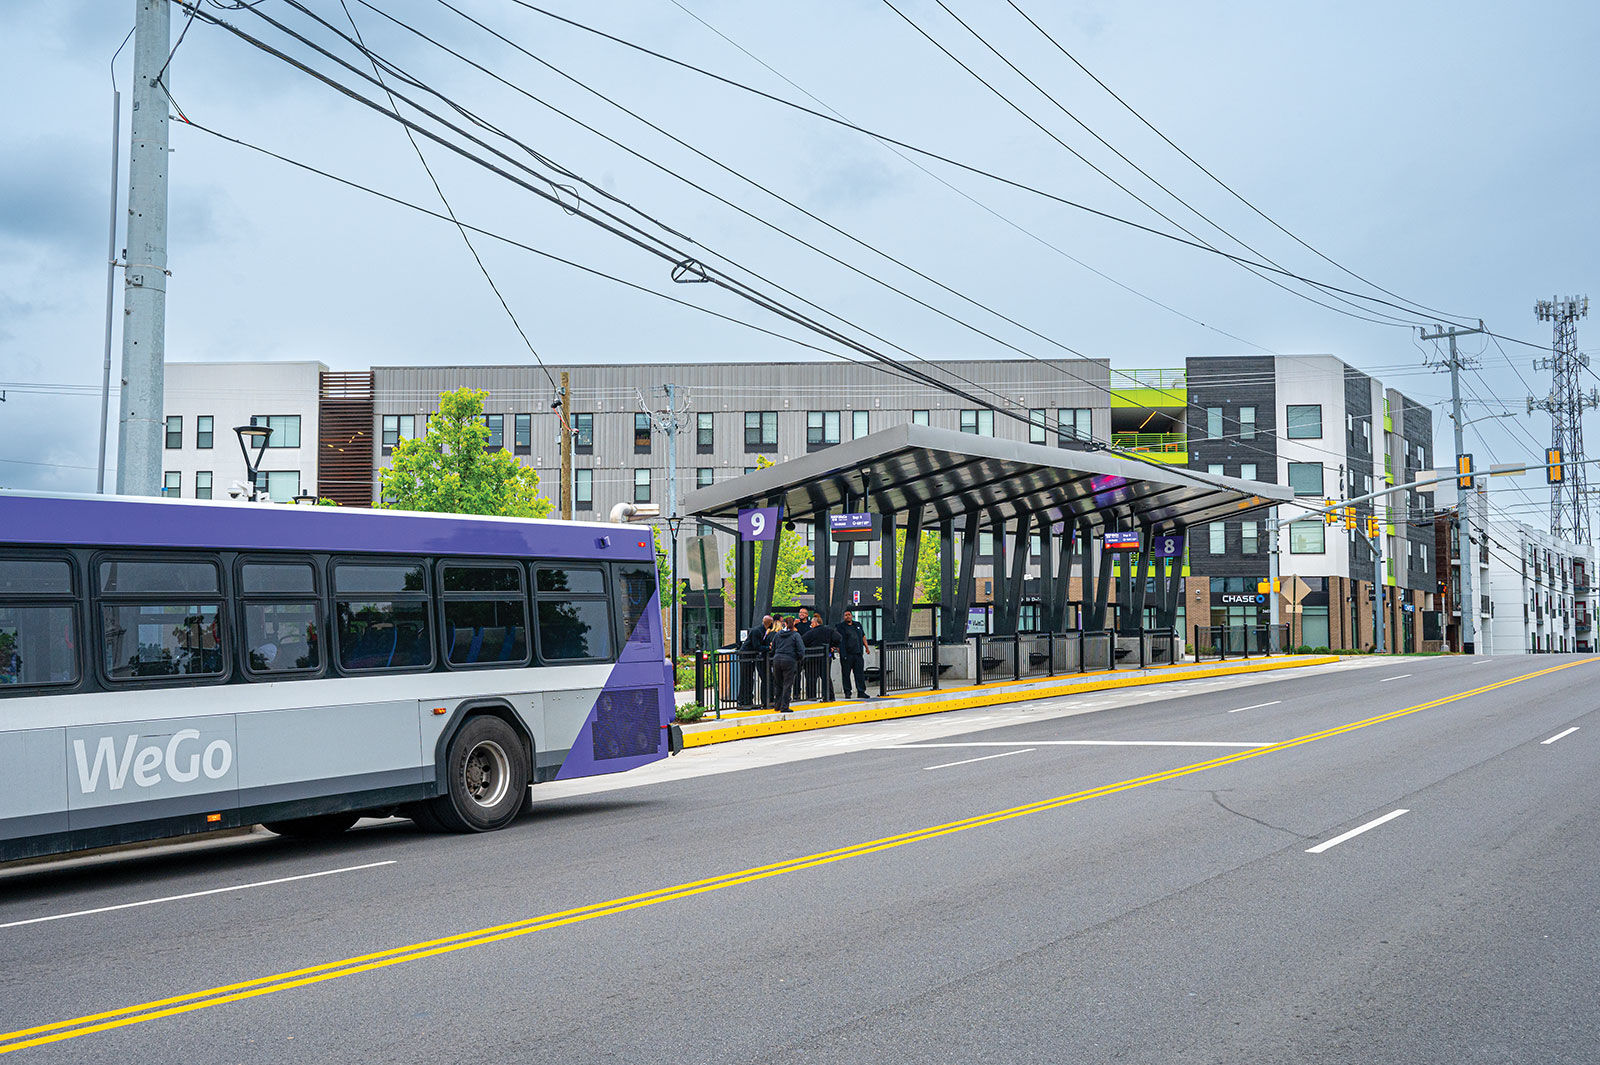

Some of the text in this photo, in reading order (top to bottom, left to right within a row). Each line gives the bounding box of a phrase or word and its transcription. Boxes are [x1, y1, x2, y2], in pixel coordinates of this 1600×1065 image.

[750, 512, 766, 536] 9
[1164, 538, 1175, 554] 8
[1222, 595, 1255, 603] CHASE
[73, 728, 233, 794] WeGo
